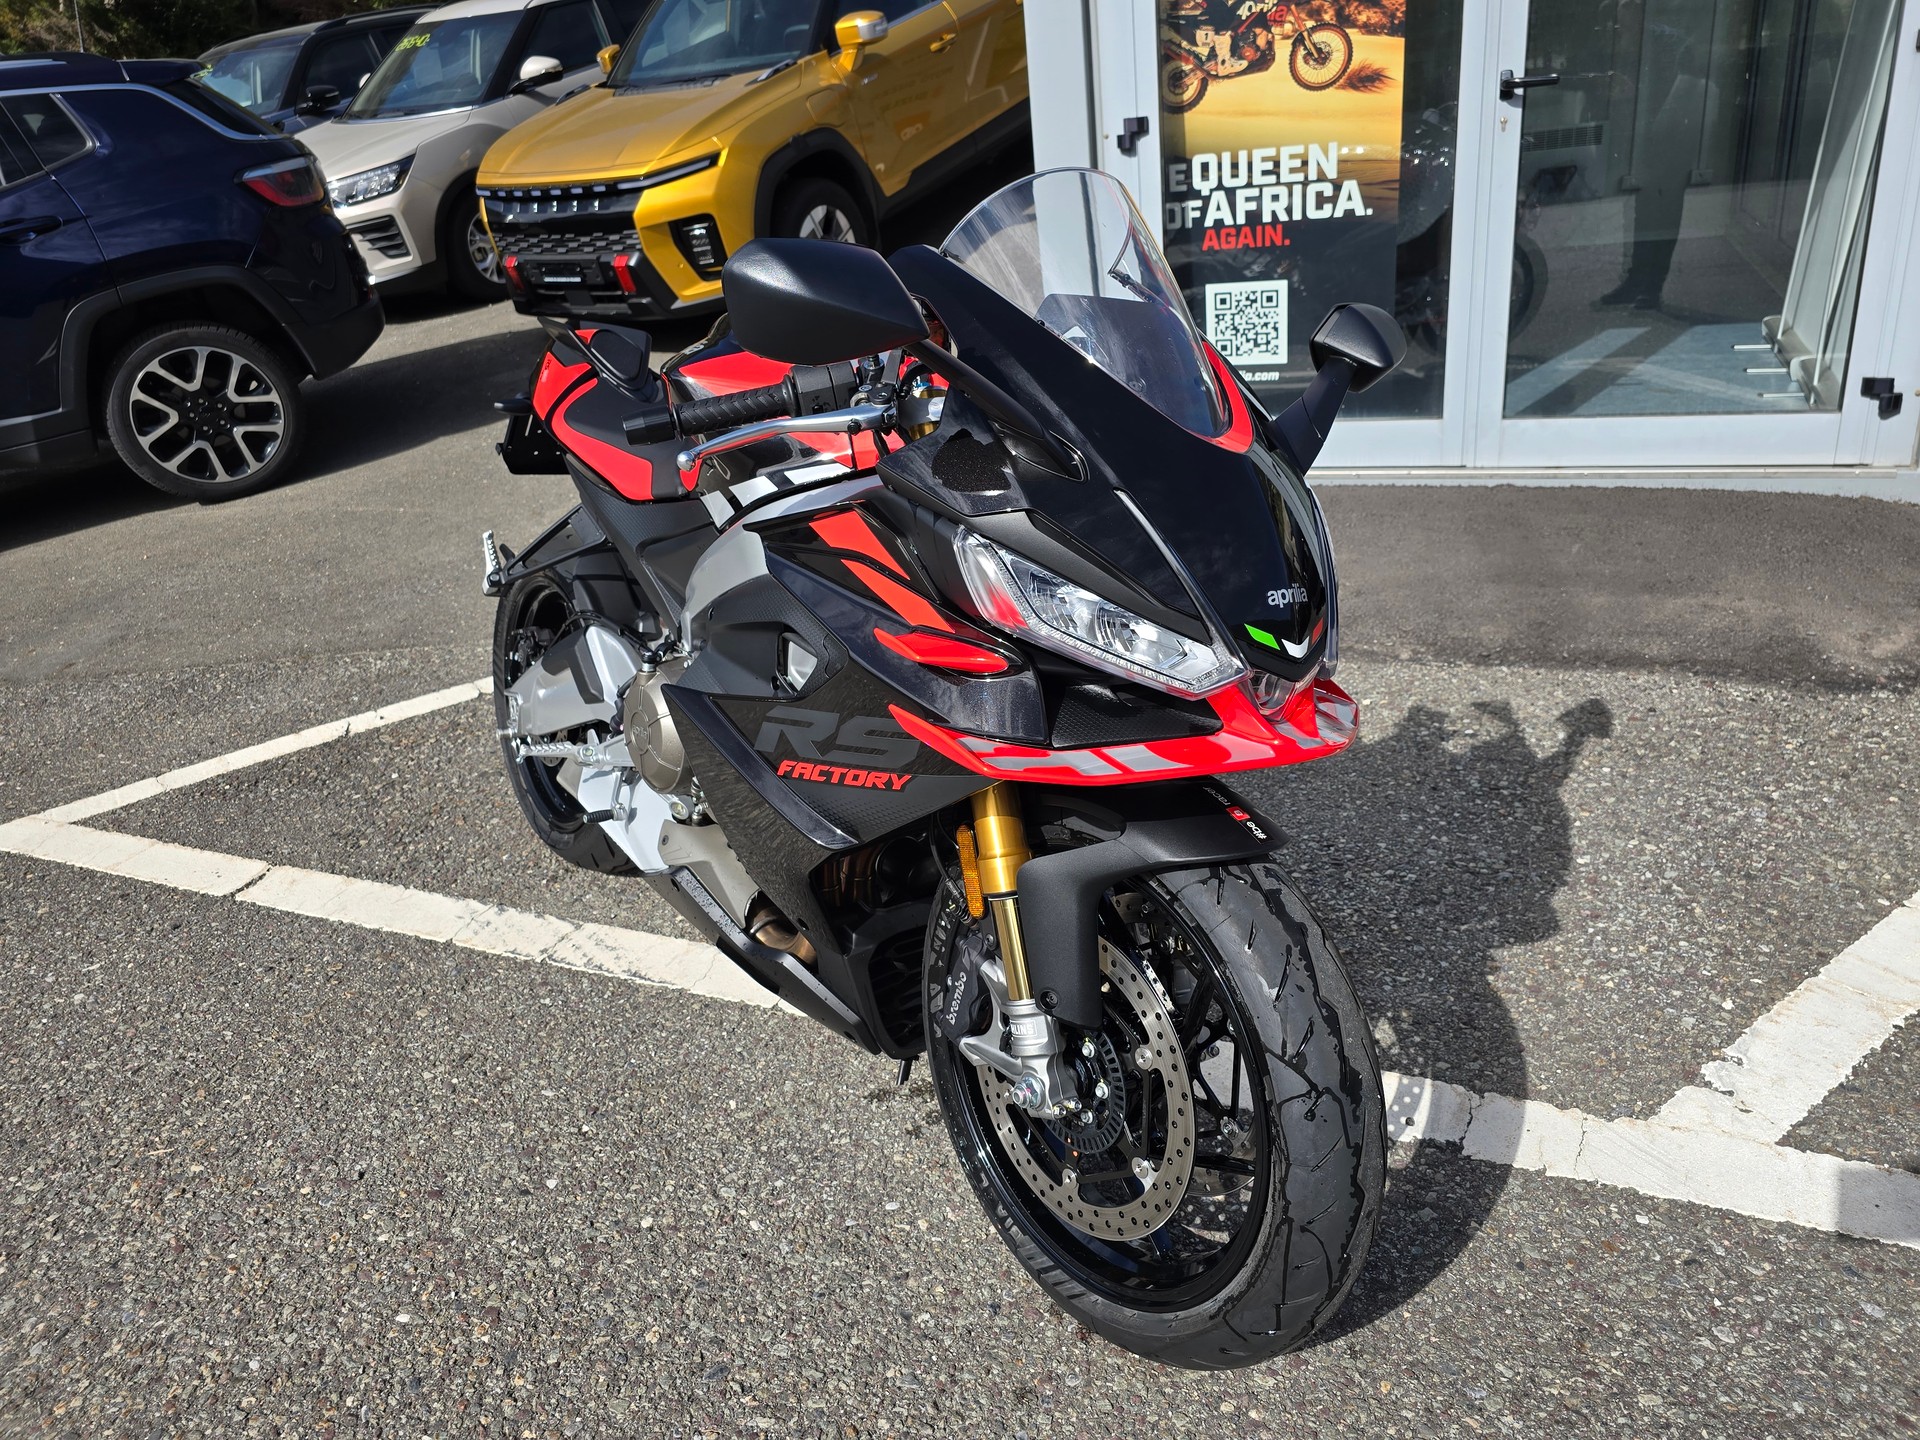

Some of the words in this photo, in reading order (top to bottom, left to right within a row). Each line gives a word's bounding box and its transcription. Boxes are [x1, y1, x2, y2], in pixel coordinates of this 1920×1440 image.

[1191, 141, 1339, 196] QUEEN
[1203, 179, 1374, 228] AFRICA.
[1202, 223, 1291, 251] AGAIN.
[1267, 582, 1309, 609] aprilia
[753, 705, 922, 769] RS
[777, 759, 912, 790] FACTORY
[1202, 786, 1231, 806] racer
[1246, 820, 1268, 840] #be
[945, 971, 968, 1026] brembo
